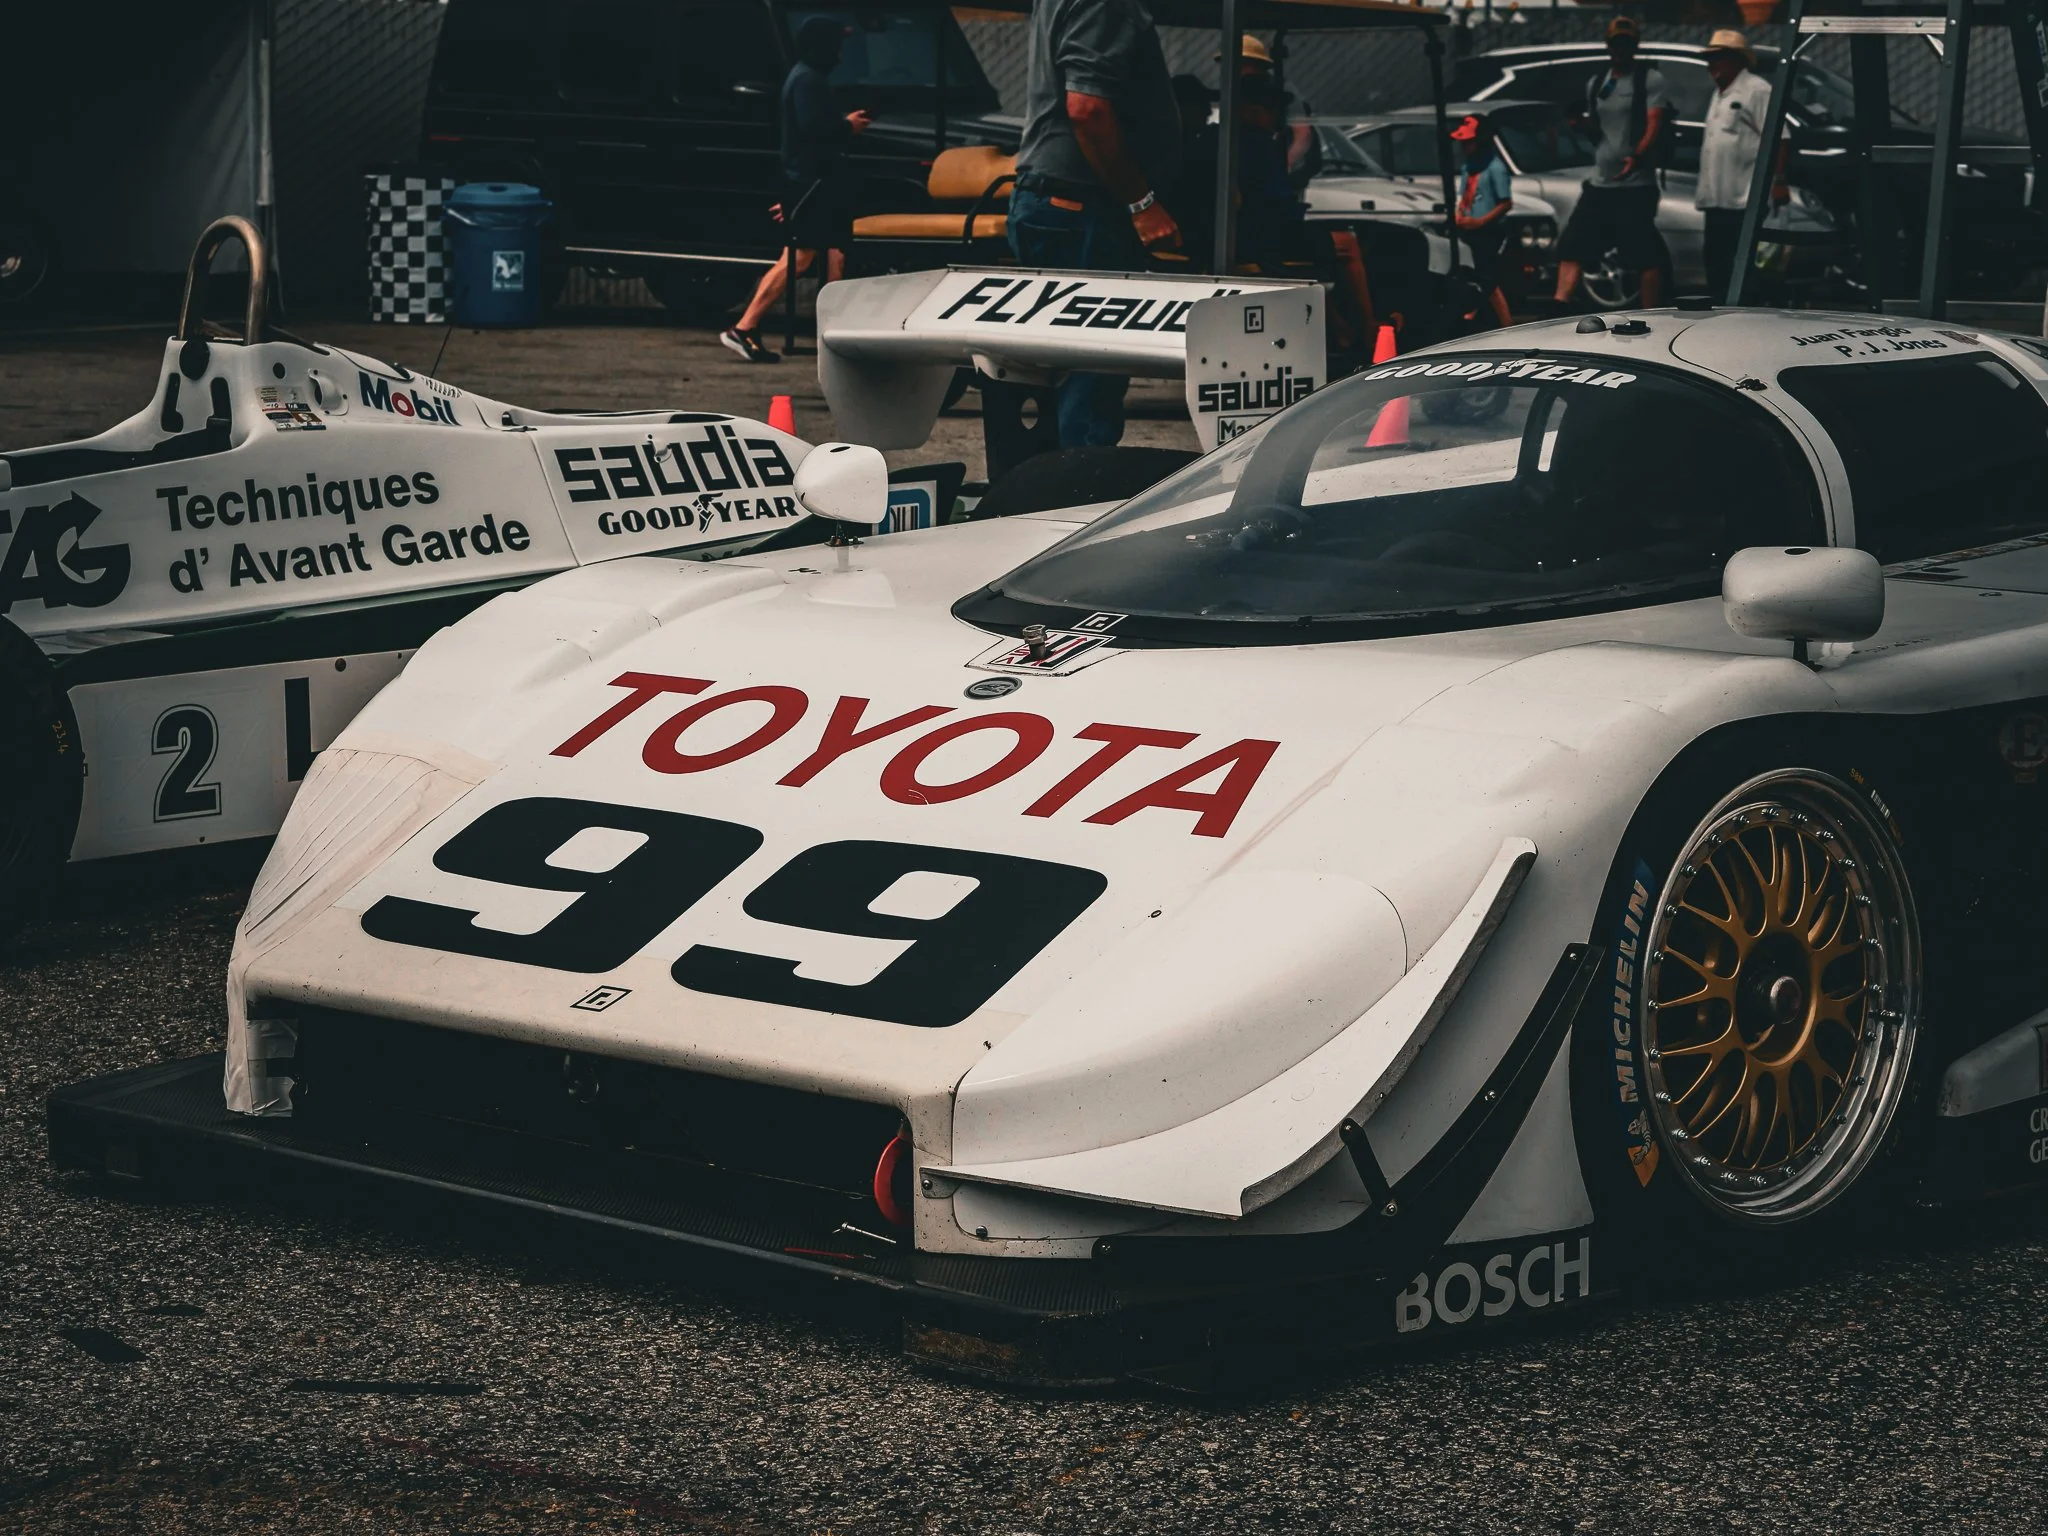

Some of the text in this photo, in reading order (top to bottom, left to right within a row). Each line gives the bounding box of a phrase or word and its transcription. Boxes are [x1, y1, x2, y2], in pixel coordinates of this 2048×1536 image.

[1790, 333, 1845, 347] Juan
[1886, 337, 1948, 351] Jones
[359, 371, 462, 426] Mobil
[156, 471, 440, 532] Techniques
[554, 425, 796, 502] saudia
[0, 490, 132, 614] AG
[230, 533, 373, 588] Avant
[381, 514, 531, 567] Garde
[151, 703, 222, 823] 2
[549, 671, 1281, 839] TOYOTA
[361, 796, 1108, 1027] 99
[1613, 879, 1650, 1103] MICHELIN
[1395, 1237, 1590, 1333] BOSCH
